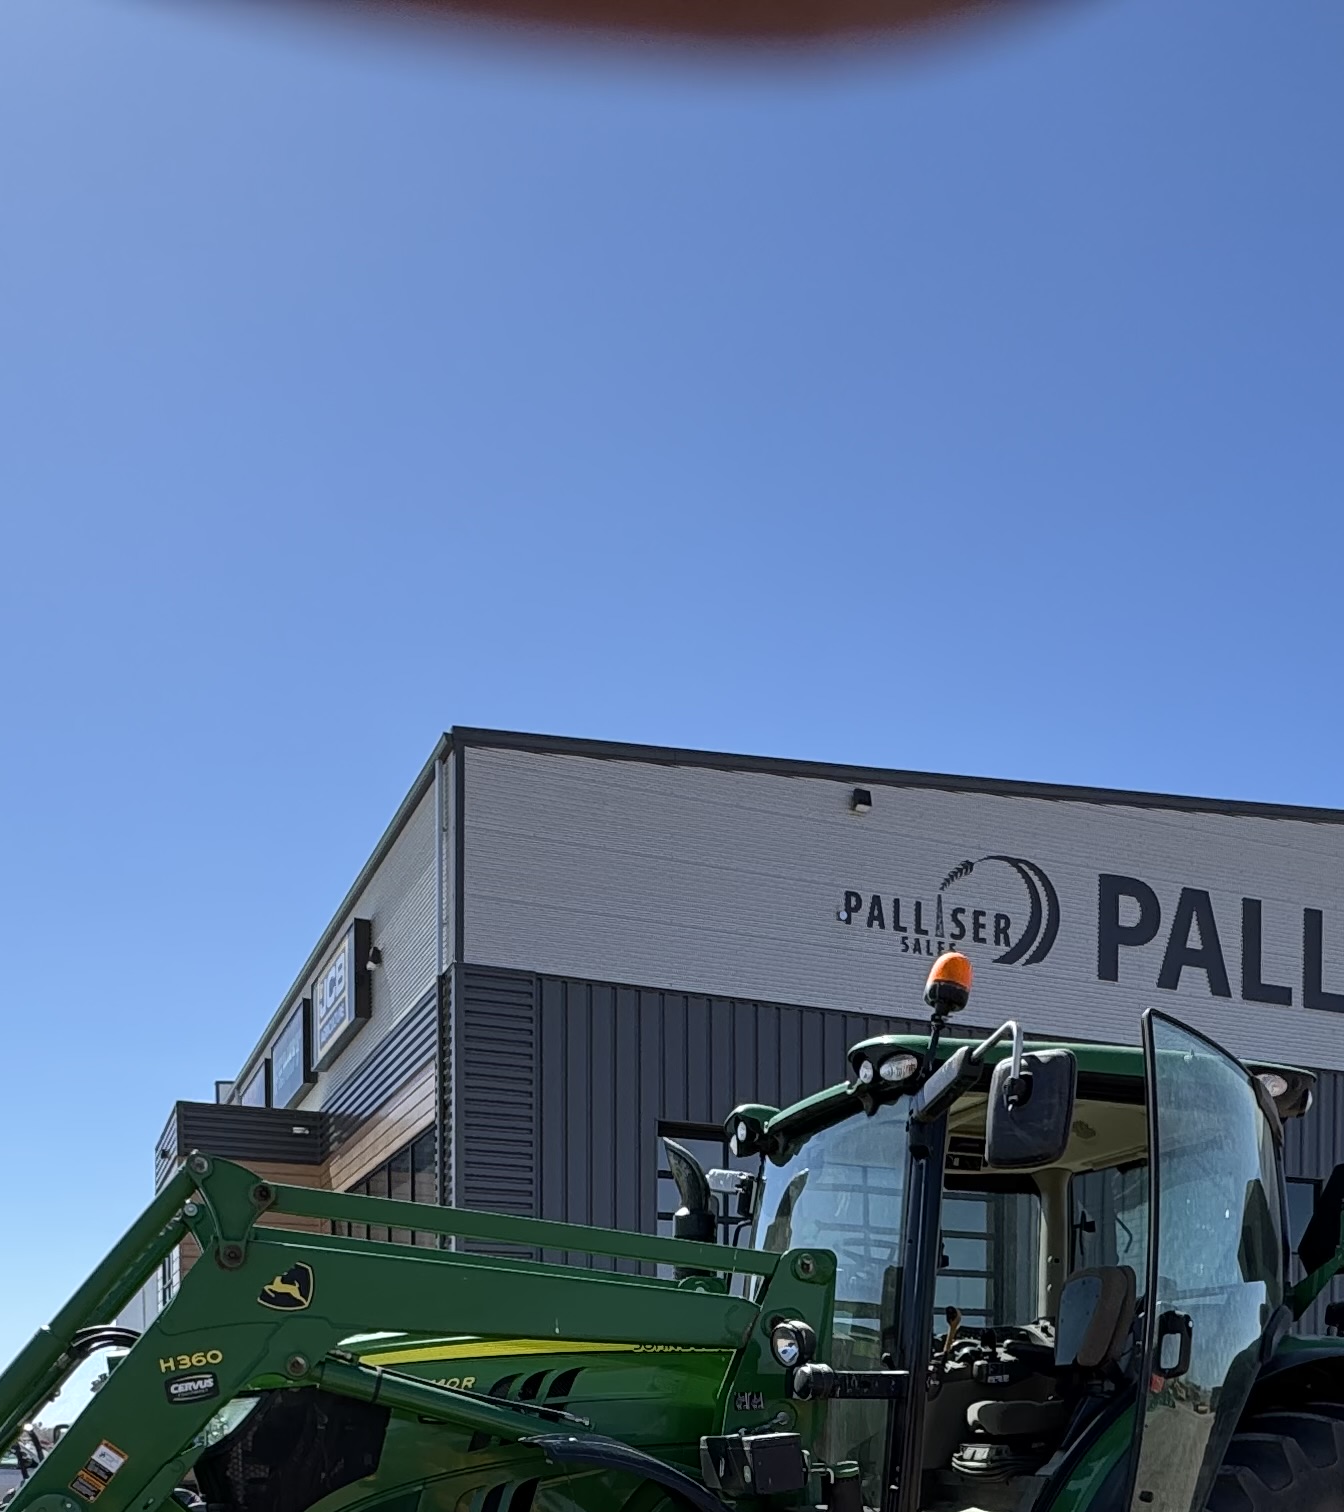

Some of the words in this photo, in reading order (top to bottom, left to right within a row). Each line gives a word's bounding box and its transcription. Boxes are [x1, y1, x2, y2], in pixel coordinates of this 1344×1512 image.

[843, 890, 1012, 948] PALLISER
[319, 952, 345, 1020] JCB
[159, 1349, 223, 1374] H360
[170, 1378, 214, 1394] CERVUS
